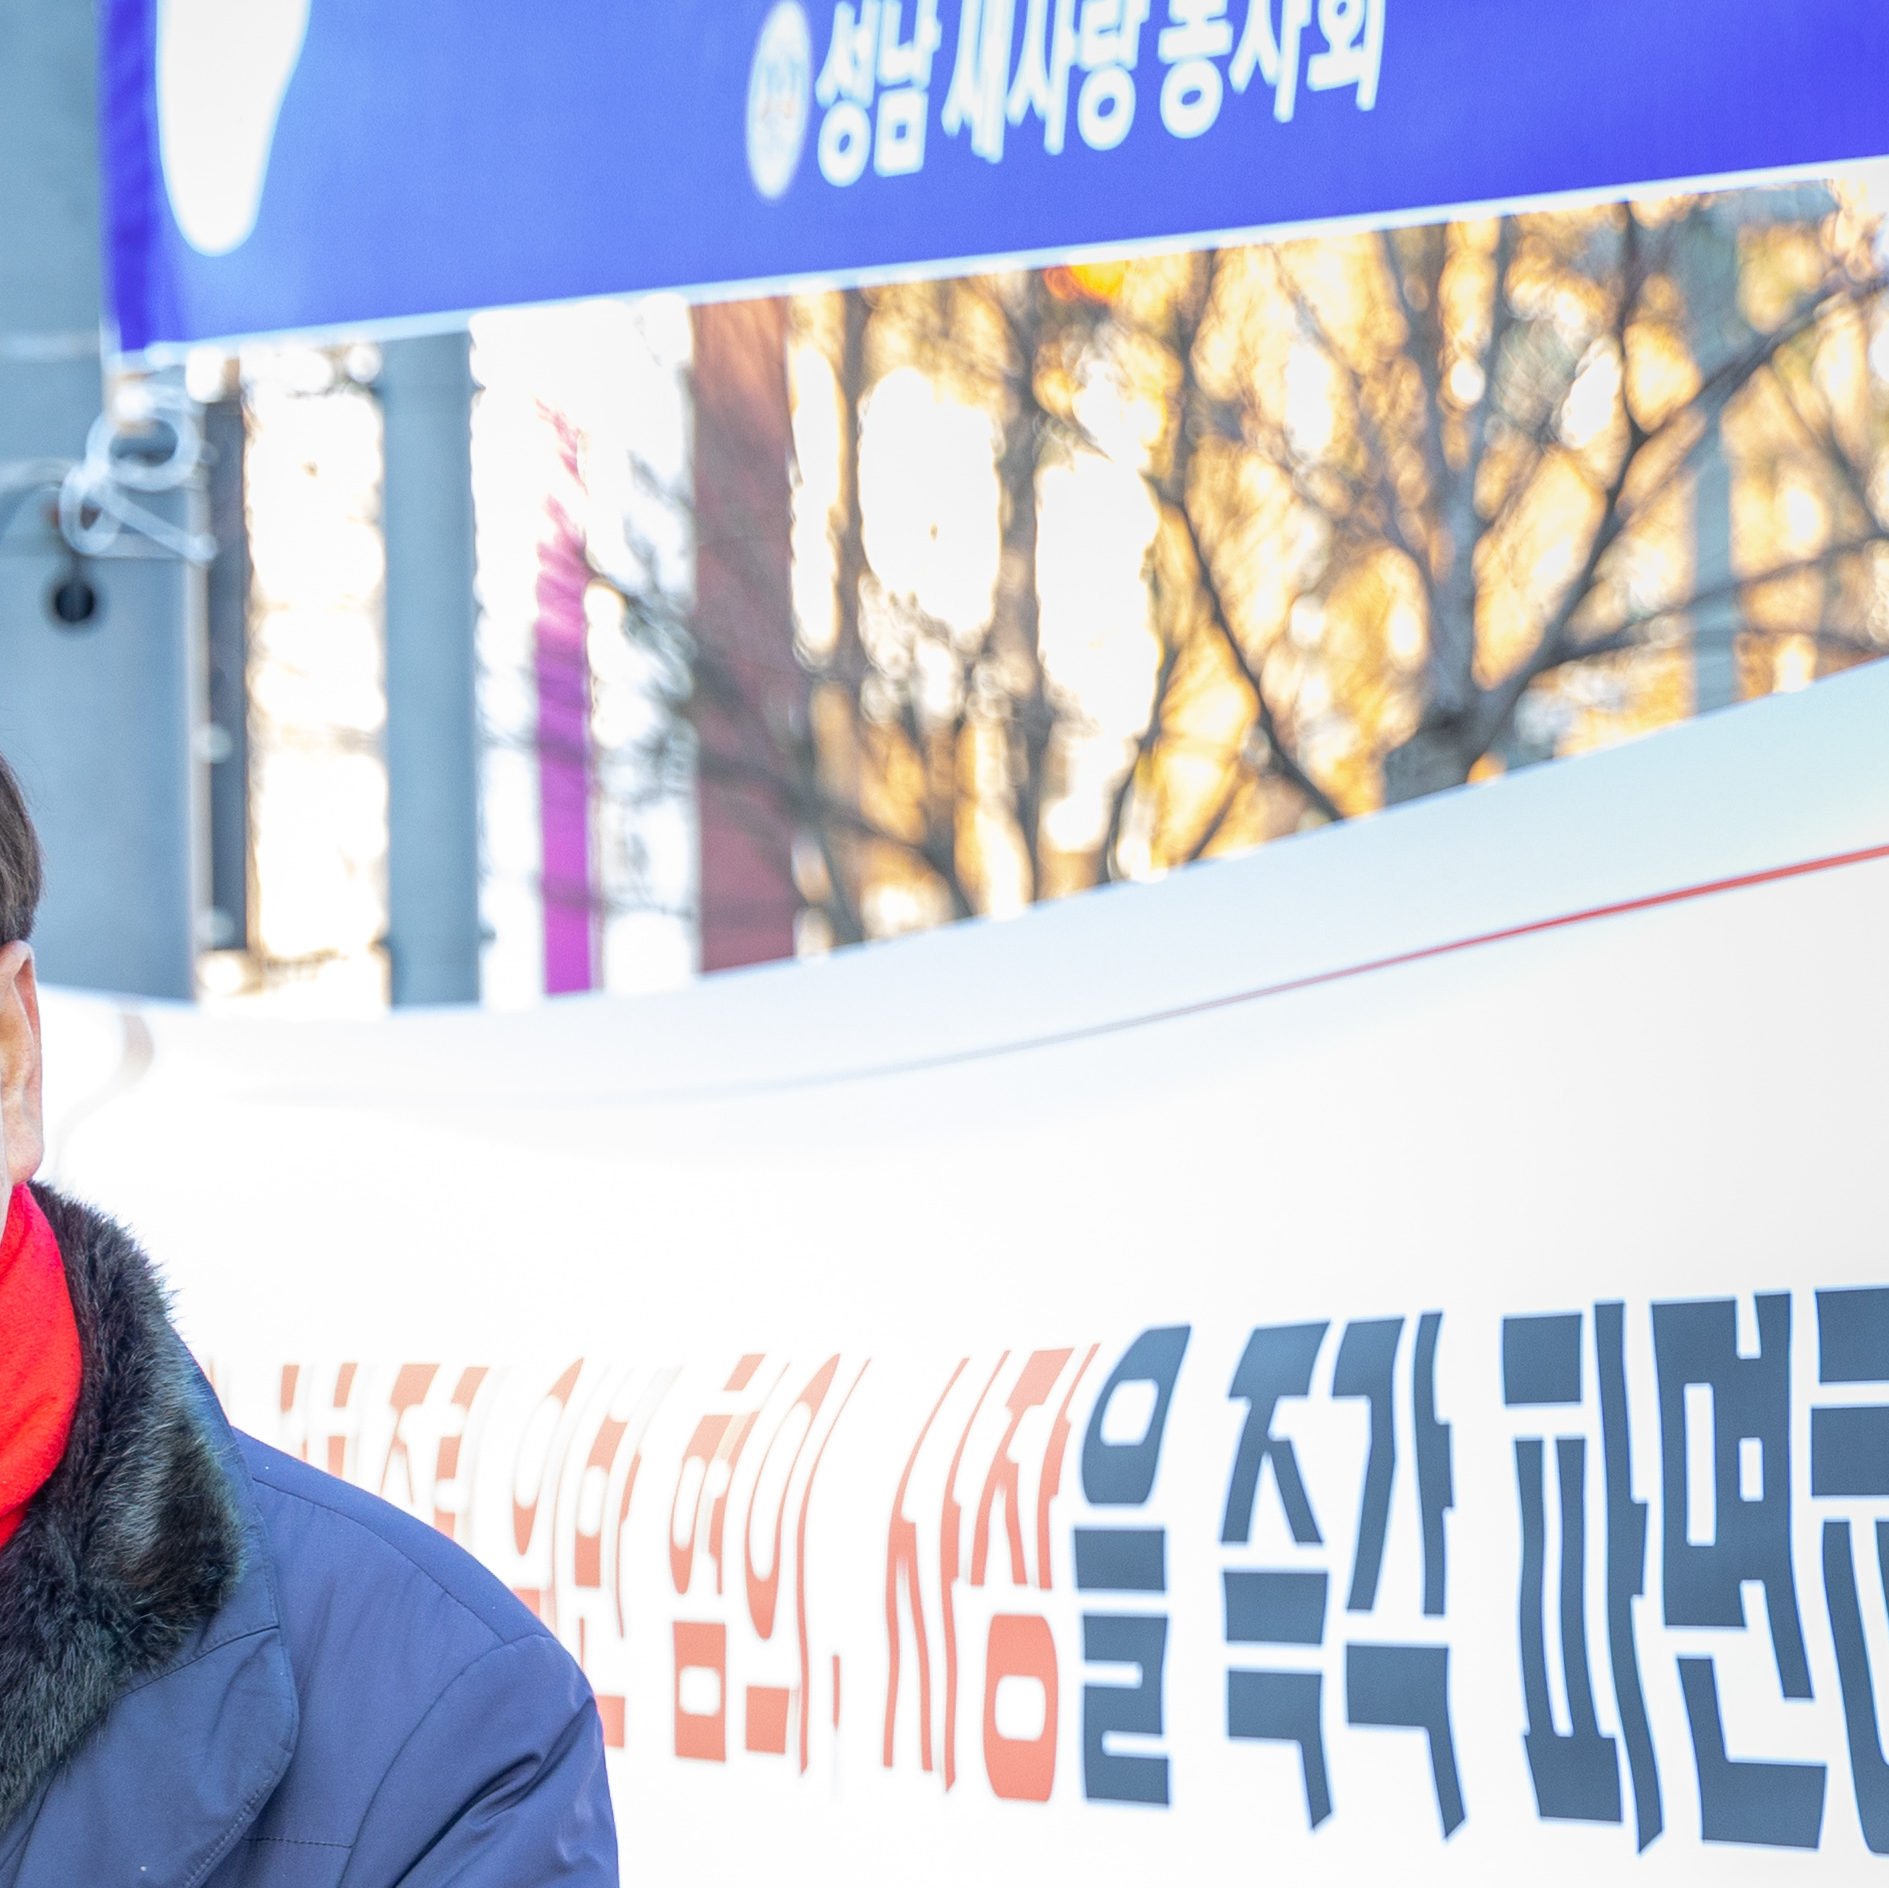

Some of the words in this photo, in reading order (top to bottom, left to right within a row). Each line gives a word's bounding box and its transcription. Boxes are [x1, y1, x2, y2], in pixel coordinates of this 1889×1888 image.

[815, 0, 942, 187] 성남
[881, 1323, 1192, 1808] 사장을
[1220, 1310, 1466, 1841] 즉각
